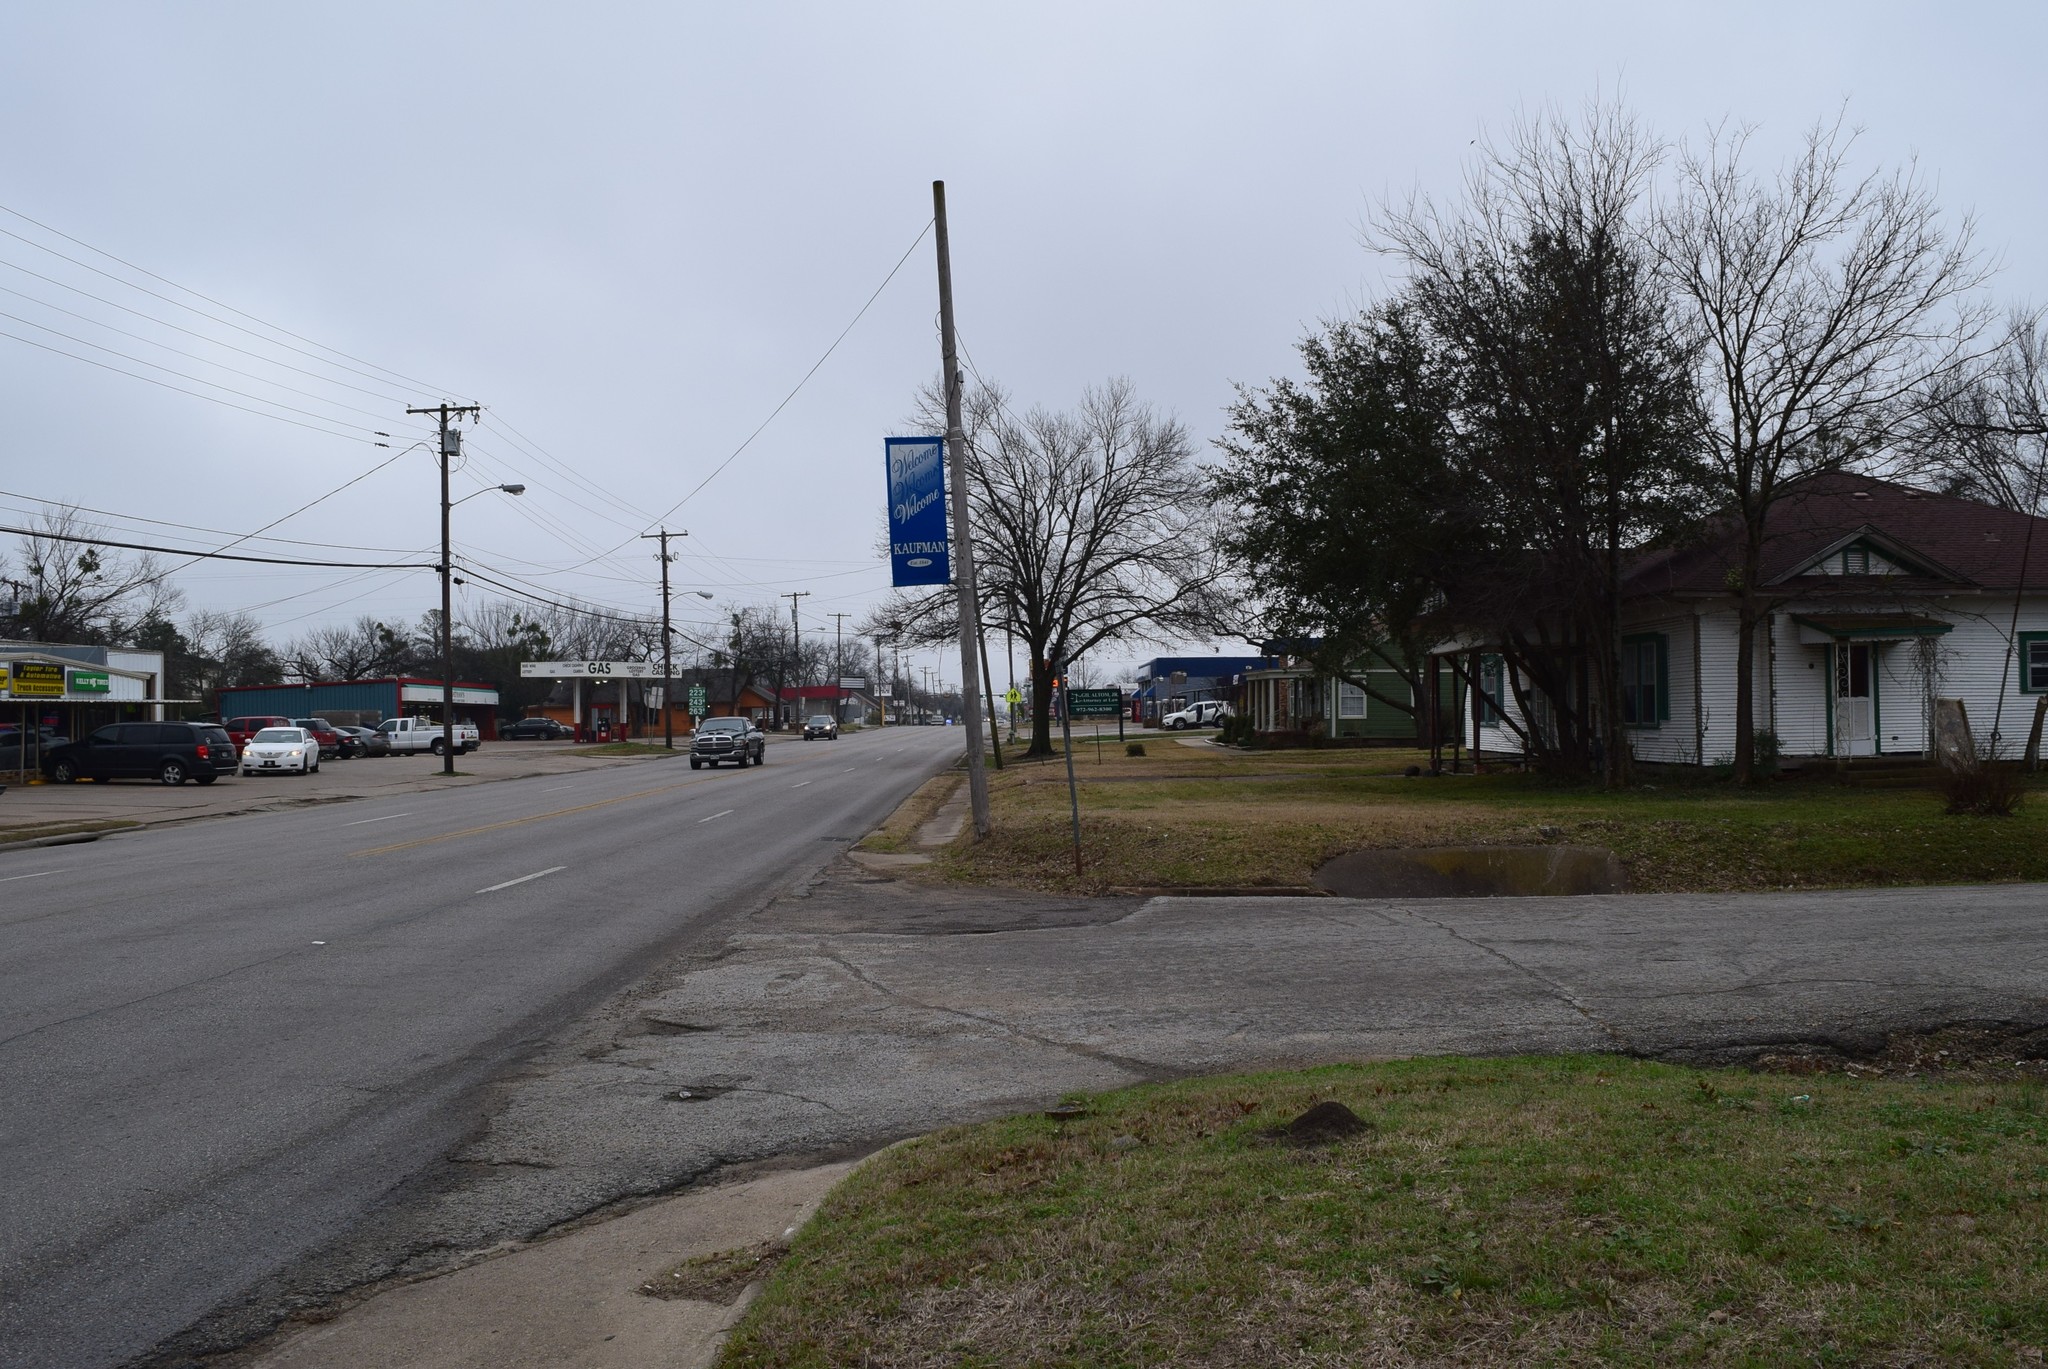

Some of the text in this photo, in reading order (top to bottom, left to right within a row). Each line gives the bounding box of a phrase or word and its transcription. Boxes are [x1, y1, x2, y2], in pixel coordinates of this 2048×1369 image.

[892, 444, 938, 478] Welcome
[893, 489, 940, 525] Welcome
[894, 541, 945, 555] KAUFMAN
[588, 662, 611, 674] GAS
